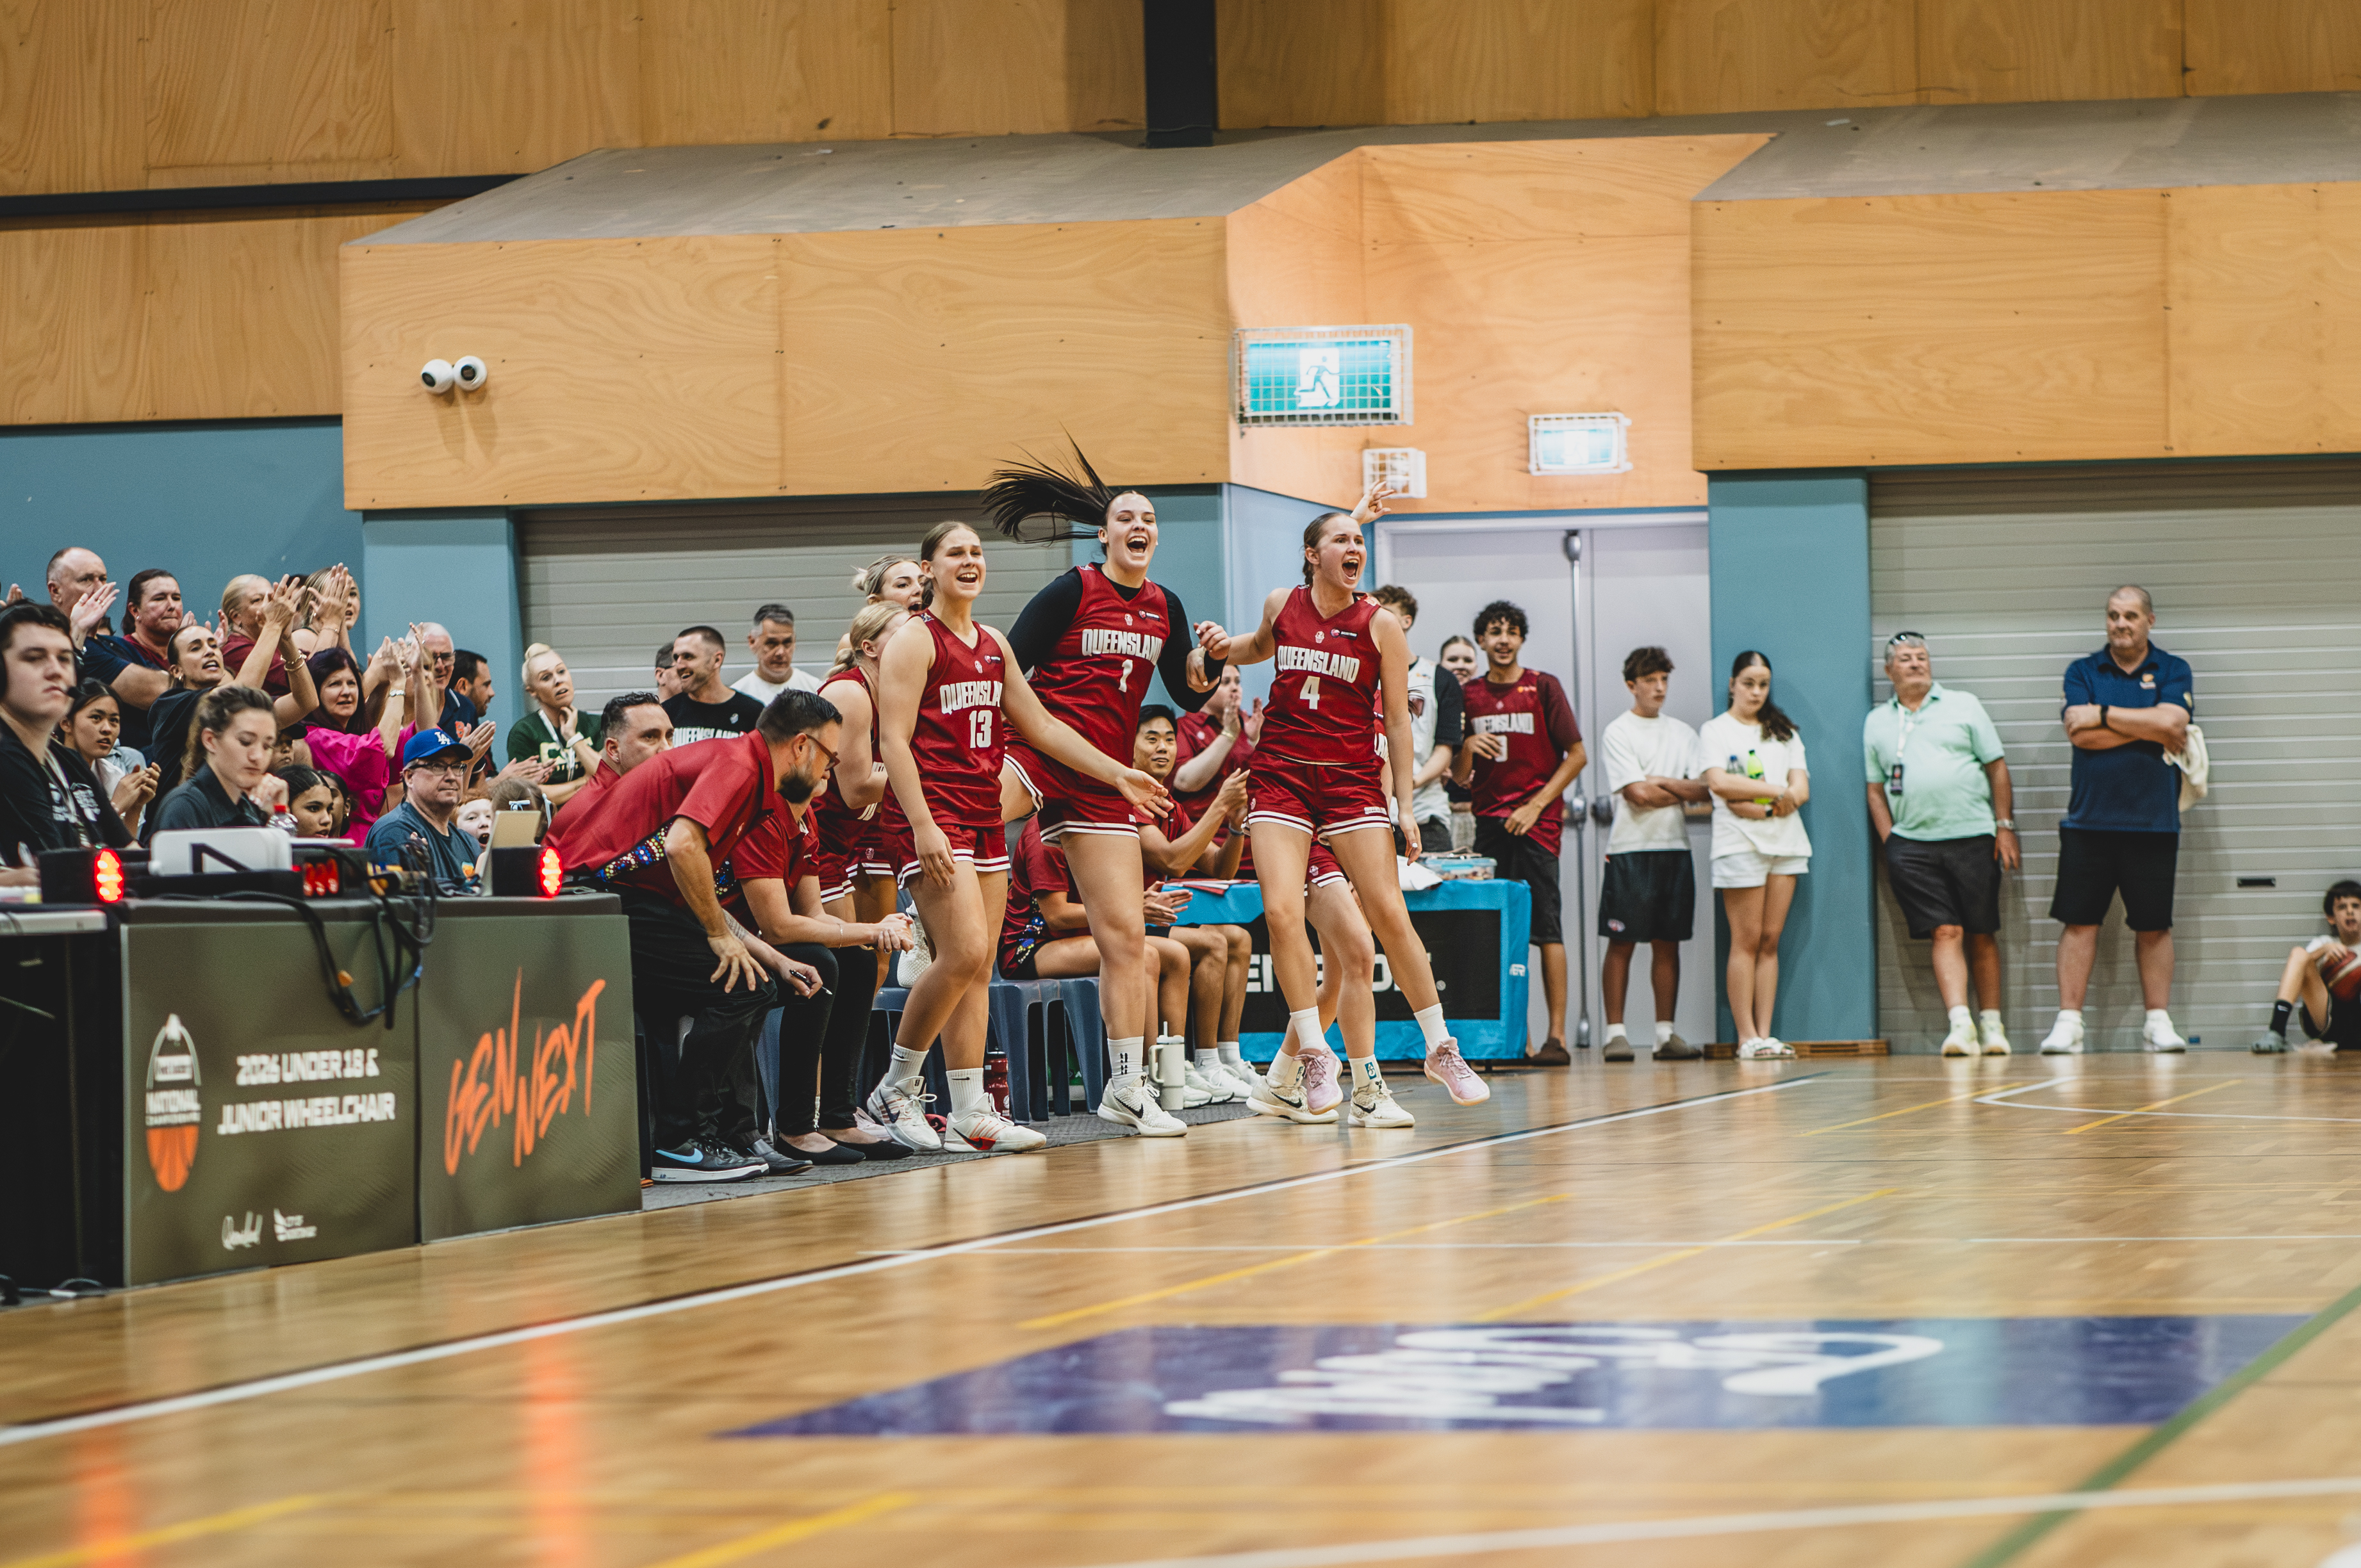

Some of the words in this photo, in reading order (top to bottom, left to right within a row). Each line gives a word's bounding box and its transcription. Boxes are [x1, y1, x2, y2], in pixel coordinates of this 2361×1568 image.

[1118, 659, 1133, 692] 1
[1278, 646, 1360, 683] QUEENSLAND
[1299, 675, 1320, 710] 4
[434, 731, 450, 744] LA
[969, 710, 993, 749] 13
[236, 1054, 281, 1085] 2026
[281, 1050, 342, 1082] UNDER
[343, 1049, 365, 1078] 18
[513, 978, 606, 1167] NEXT
[217, 1100, 283, 1135] JUNIOR
[283, 1092, 396, 1129] WHEELCHAIR
